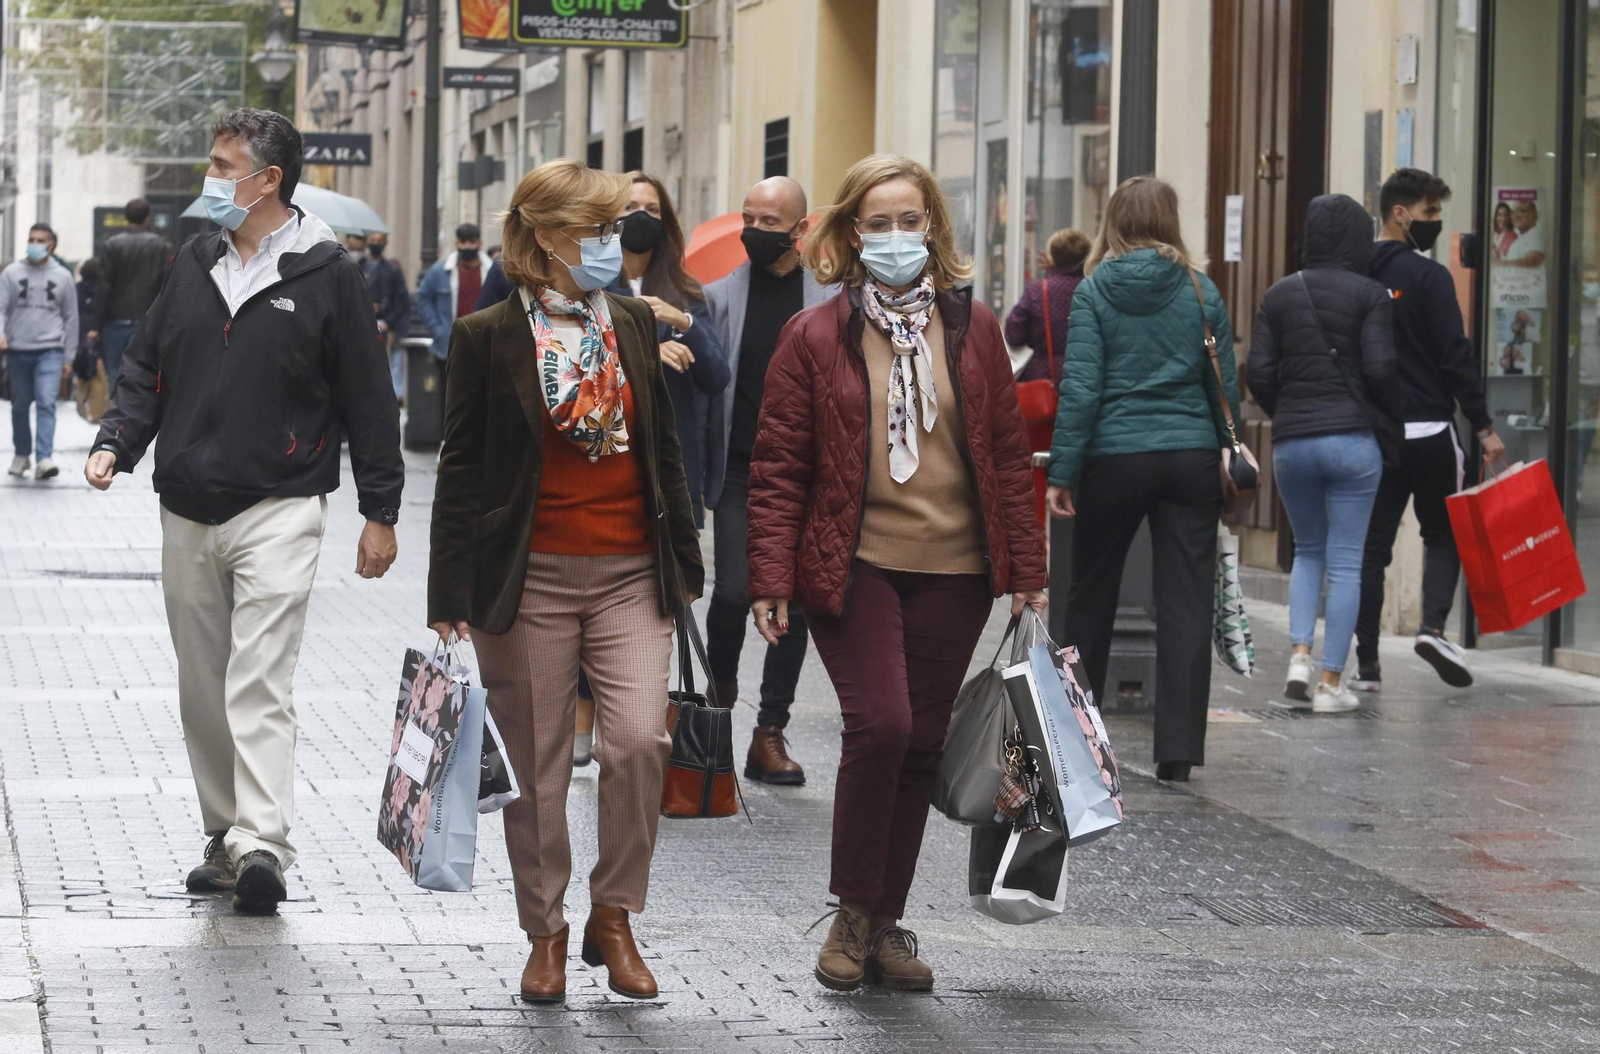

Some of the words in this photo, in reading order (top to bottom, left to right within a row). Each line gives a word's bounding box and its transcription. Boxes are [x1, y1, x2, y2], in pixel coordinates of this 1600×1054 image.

[303, 146, 367, 161] ZARA
[543, 350, 560, 412] BIMBA
[434, 738, 461, 835] womensecret.com
